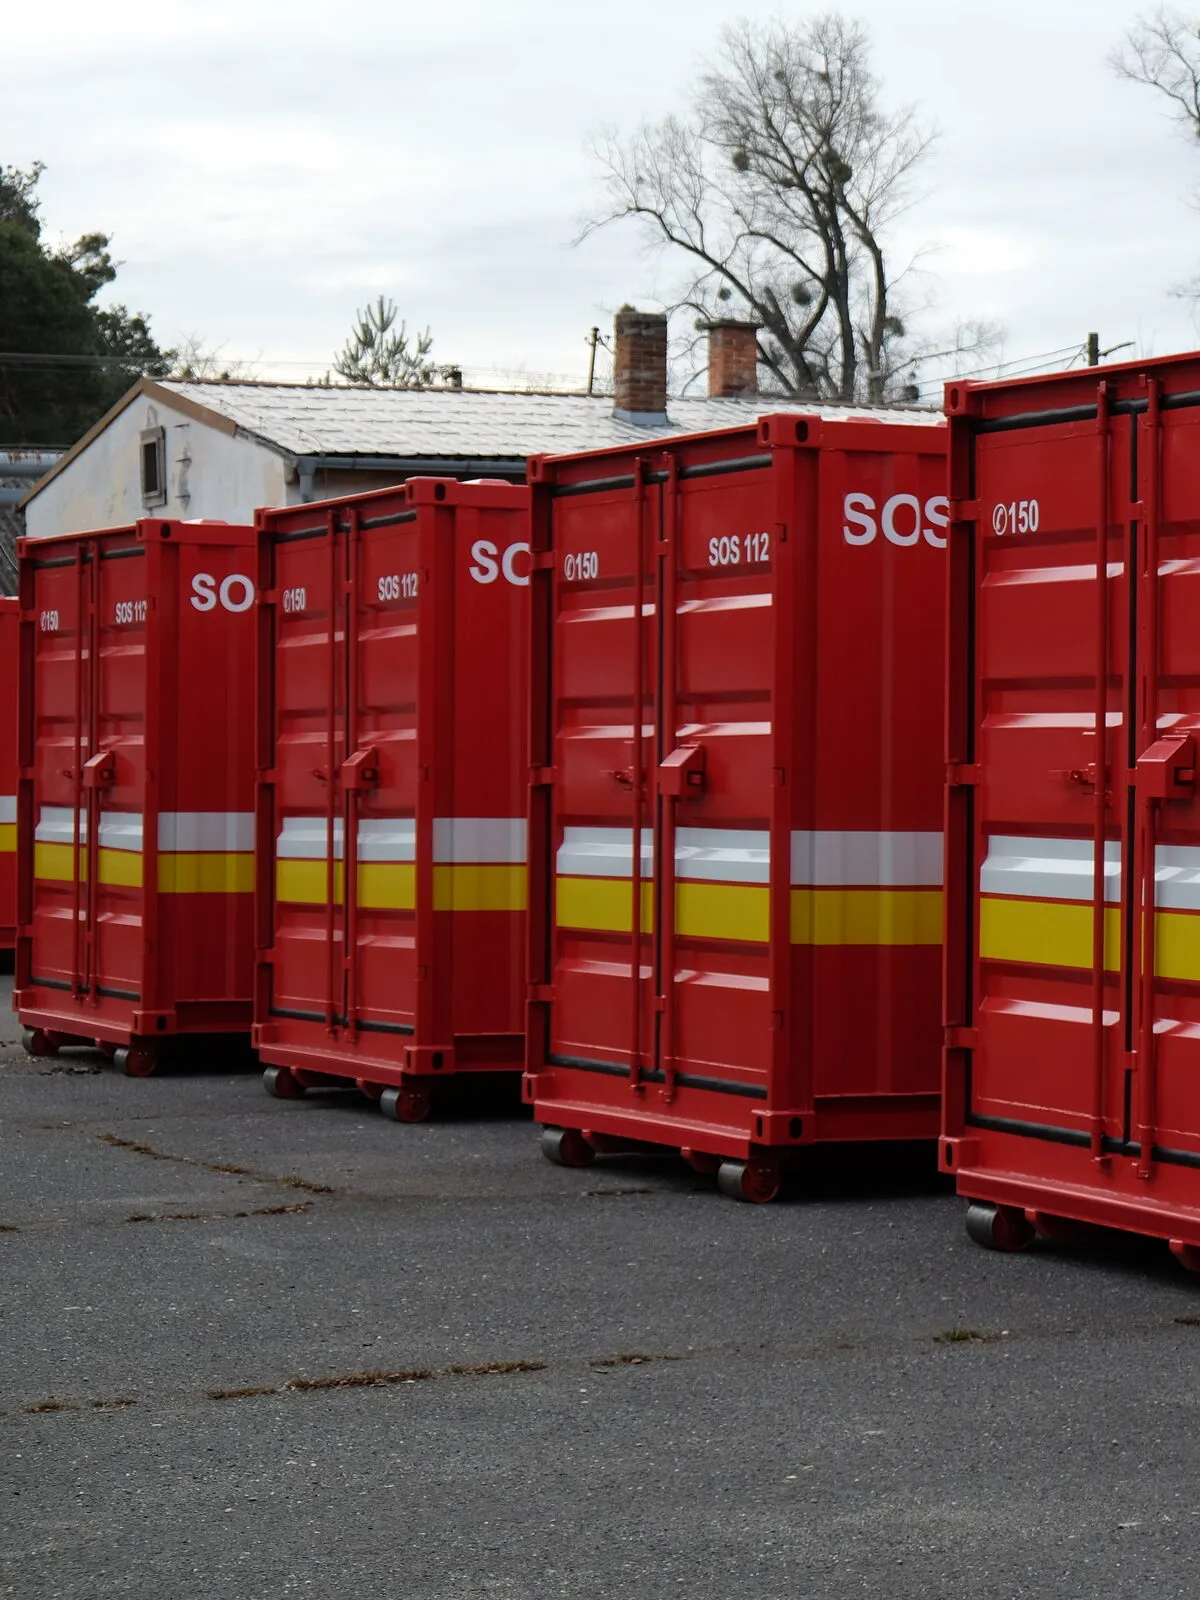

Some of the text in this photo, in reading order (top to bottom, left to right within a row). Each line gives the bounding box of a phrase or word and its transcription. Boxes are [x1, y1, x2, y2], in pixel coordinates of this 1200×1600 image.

[843, 492, 948, 548] SOS
[1008, 500, 1039, 533] 150
[708, 532, 769, 566] SOS 112
[575, 552, 599, 580] 150
[290, 588, 306, 612] 150
[377, 573, 418, 600] SOS 112
[115, 600, 148, 624] SOS 112
